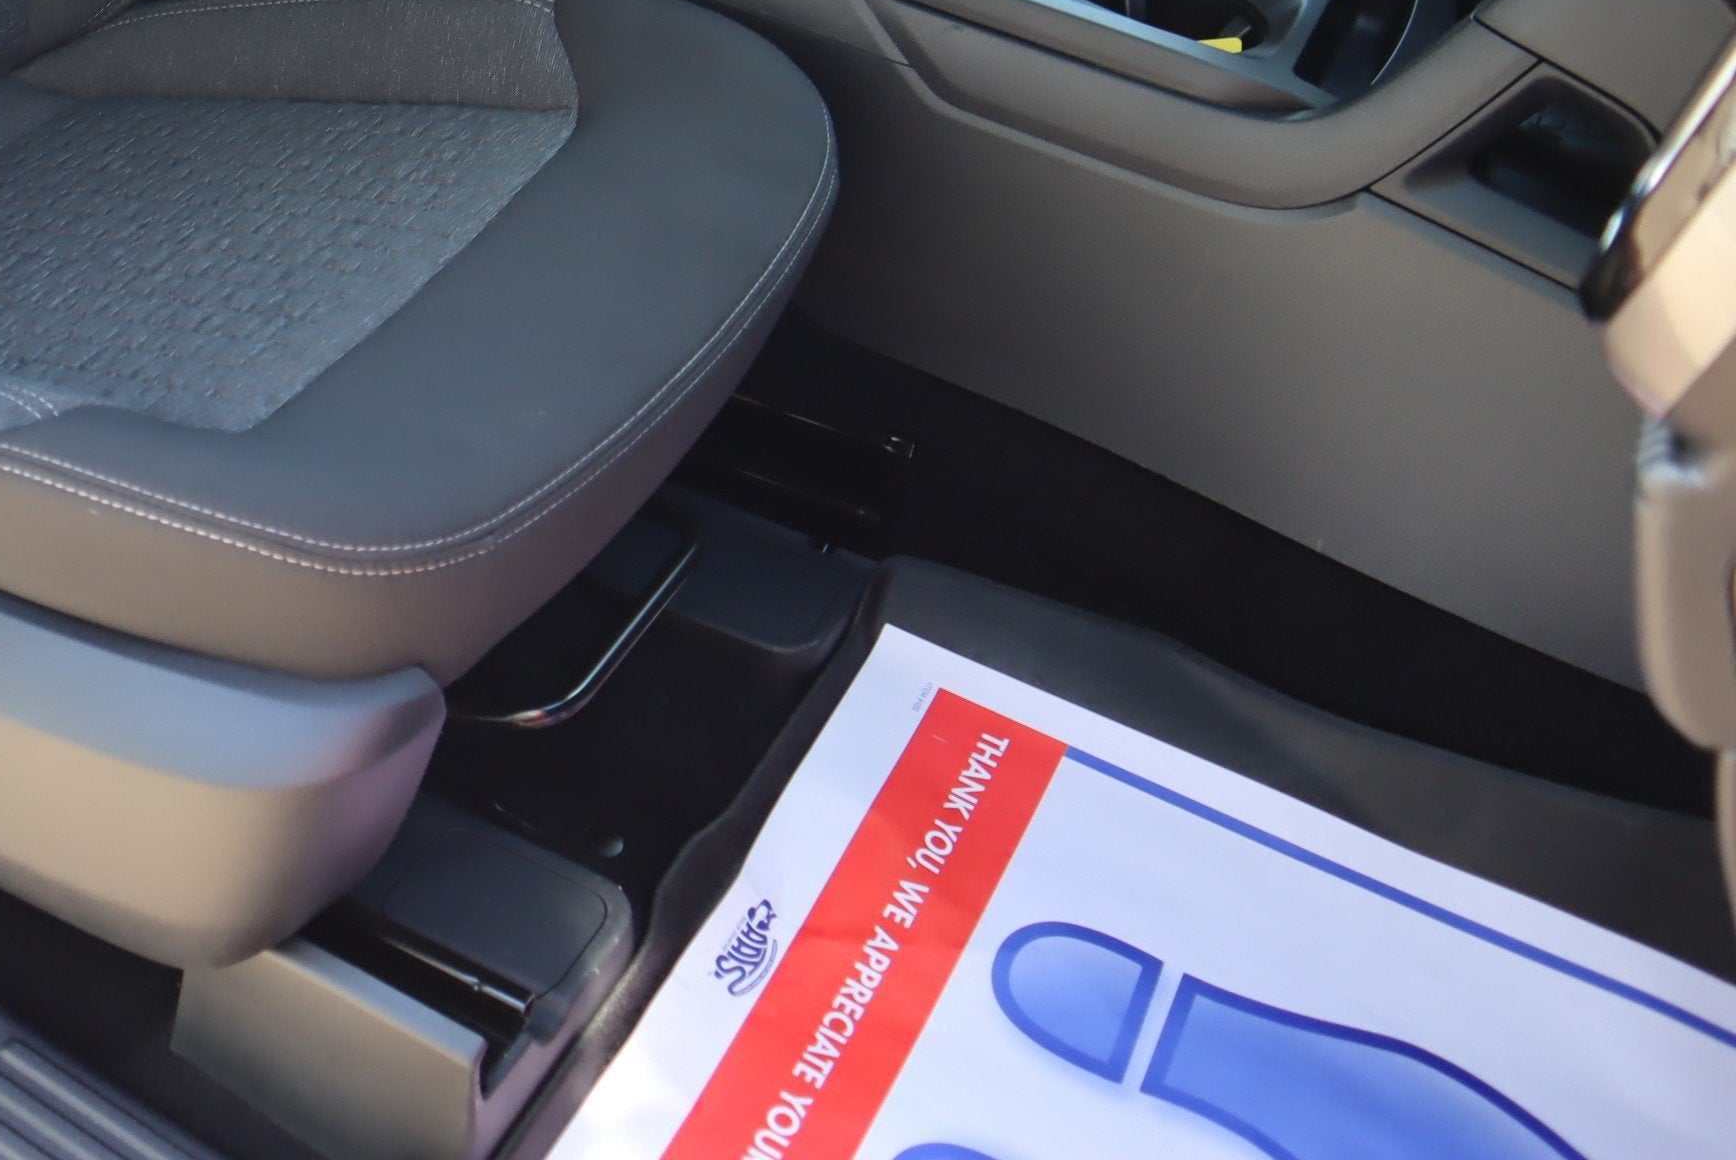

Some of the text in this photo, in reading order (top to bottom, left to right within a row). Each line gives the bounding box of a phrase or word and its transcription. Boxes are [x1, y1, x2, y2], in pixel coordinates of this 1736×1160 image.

[944, 733, 1010, 821] THANK
[906, 819, 964, 875] YOU,
[882, 879, 931, 929] WE
[792, 925, 901, 1090] APPRECIATE
